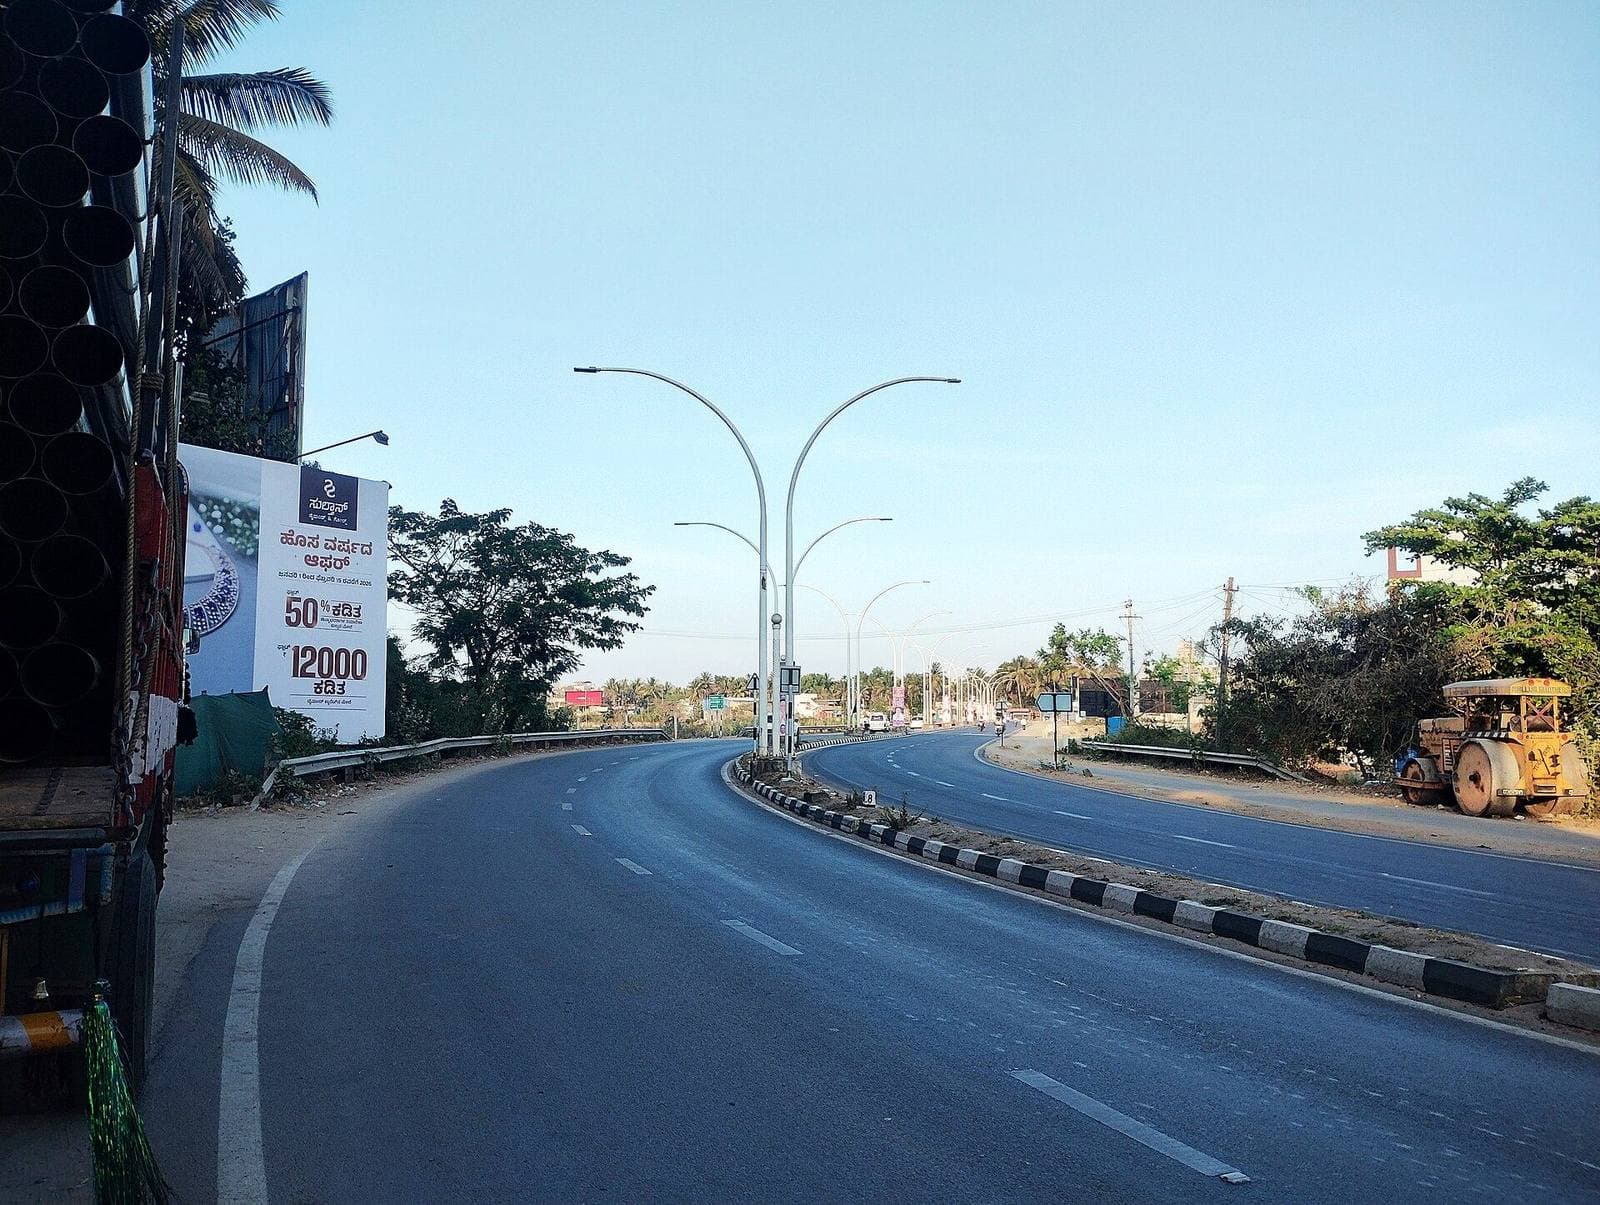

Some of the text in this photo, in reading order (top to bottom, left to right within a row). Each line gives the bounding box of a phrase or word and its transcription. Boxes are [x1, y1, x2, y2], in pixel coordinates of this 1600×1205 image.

[280, 529, 373, 556] ಹೊಸ ವರ್ಷದ
[304, 554, 350, 572] ಆಫರ್
[332, 603, 362, 618] ಕಡಿತ
[292, 645, 367, 680] 12000
[313, 680, 346, 695] ಕಡಿತ
